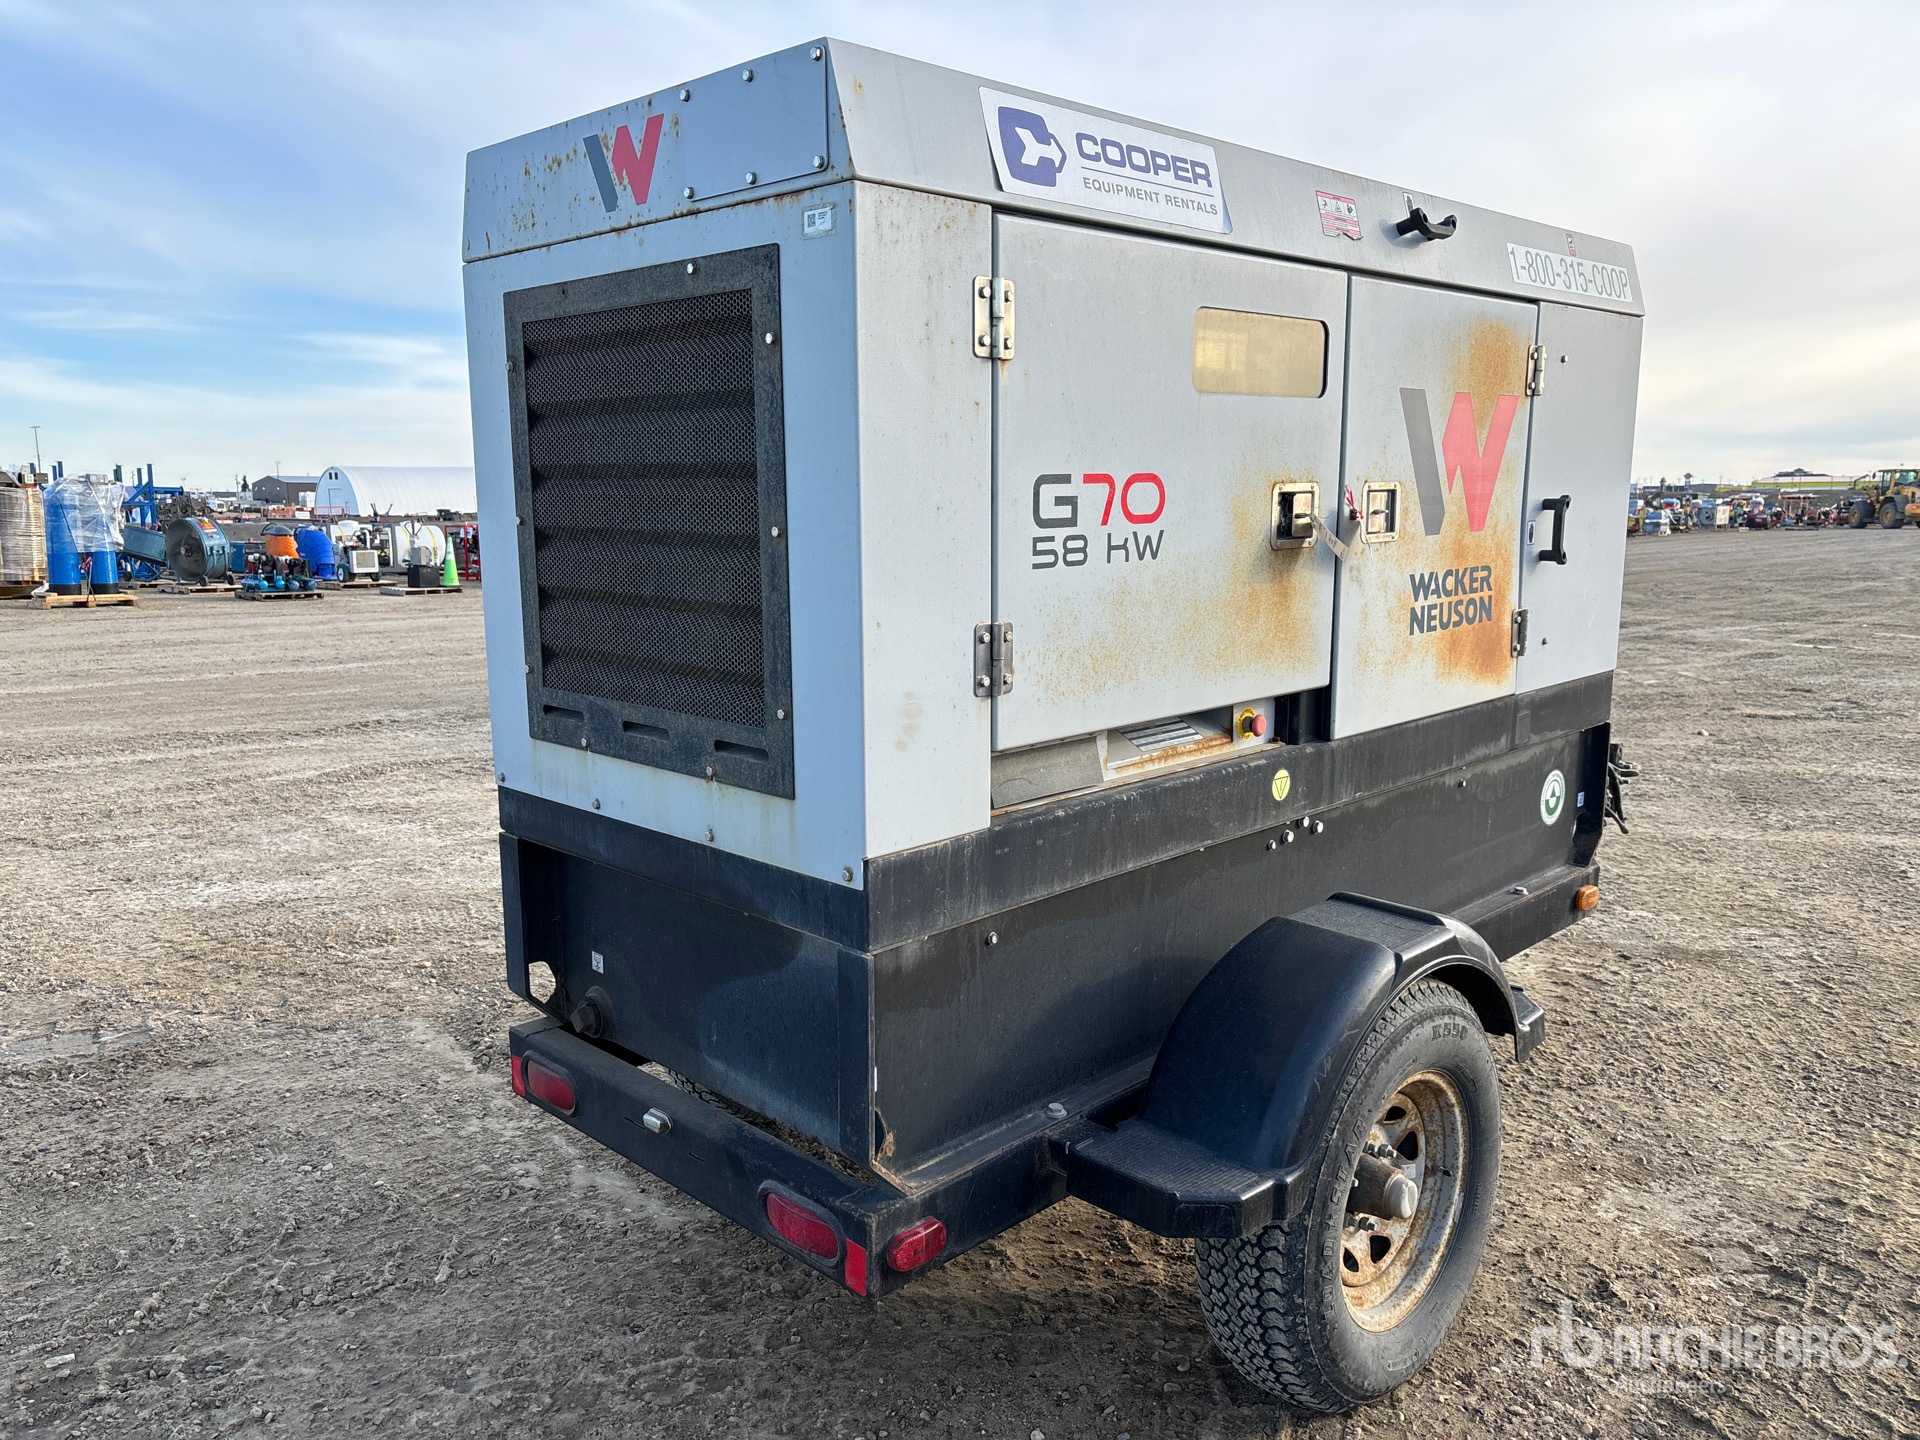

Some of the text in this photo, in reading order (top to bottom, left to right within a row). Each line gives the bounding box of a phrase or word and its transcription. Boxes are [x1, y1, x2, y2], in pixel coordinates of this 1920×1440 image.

[1075, 132, 1213, 188] COOPER
[1083, 177, 1218, 216] EQUIPMENT RENTALS
[1510, 246, 1628, 299] 1-800-315-COOP
[1032, 472, 1166, 529] G70
[1032, 530, 1165, 570] 58 kW
[1409, 564, 1493, 601] WACKER
[1409, 594, 1493, 636] NEUSON
